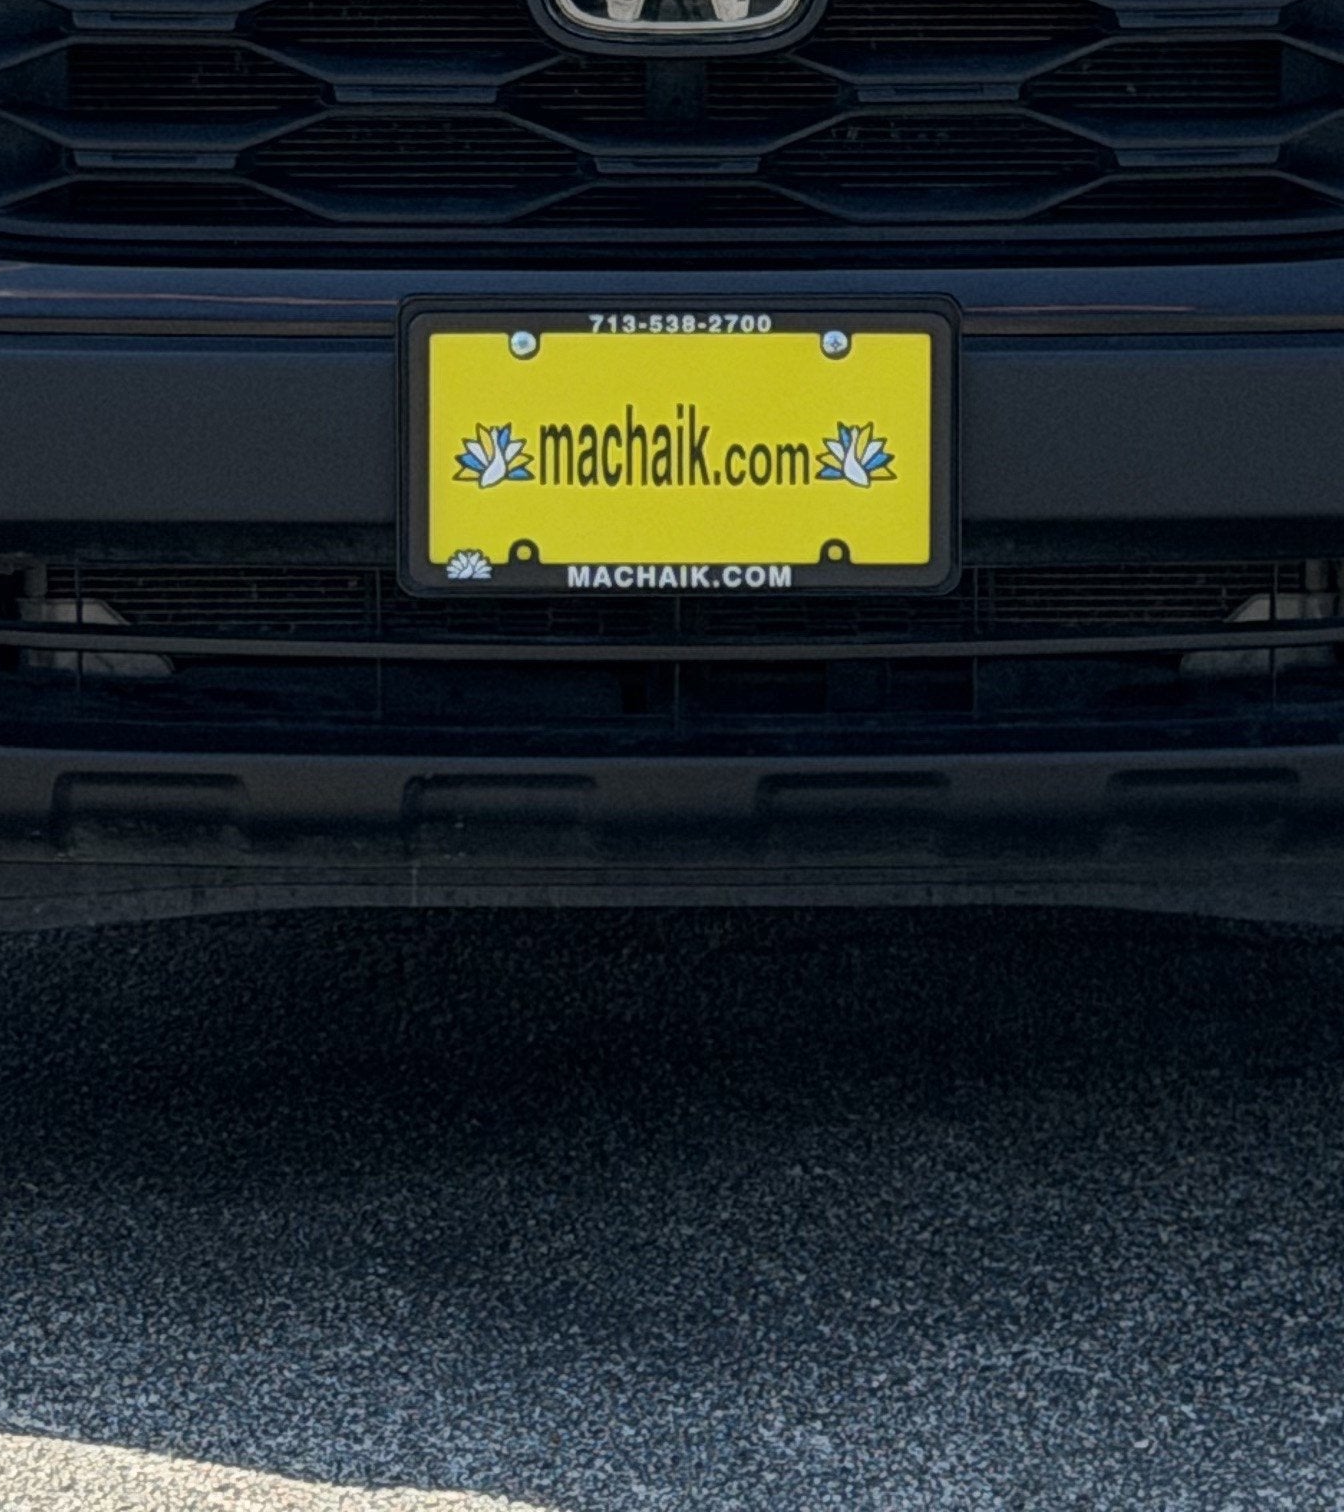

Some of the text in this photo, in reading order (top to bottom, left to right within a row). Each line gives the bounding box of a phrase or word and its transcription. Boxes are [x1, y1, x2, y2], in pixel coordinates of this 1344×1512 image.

[588, 313, 773, 334] 713-538-2700
[539, 403, 811, 487] machaik.com
[567, 565, 792, 588] MACHAIK.COM
